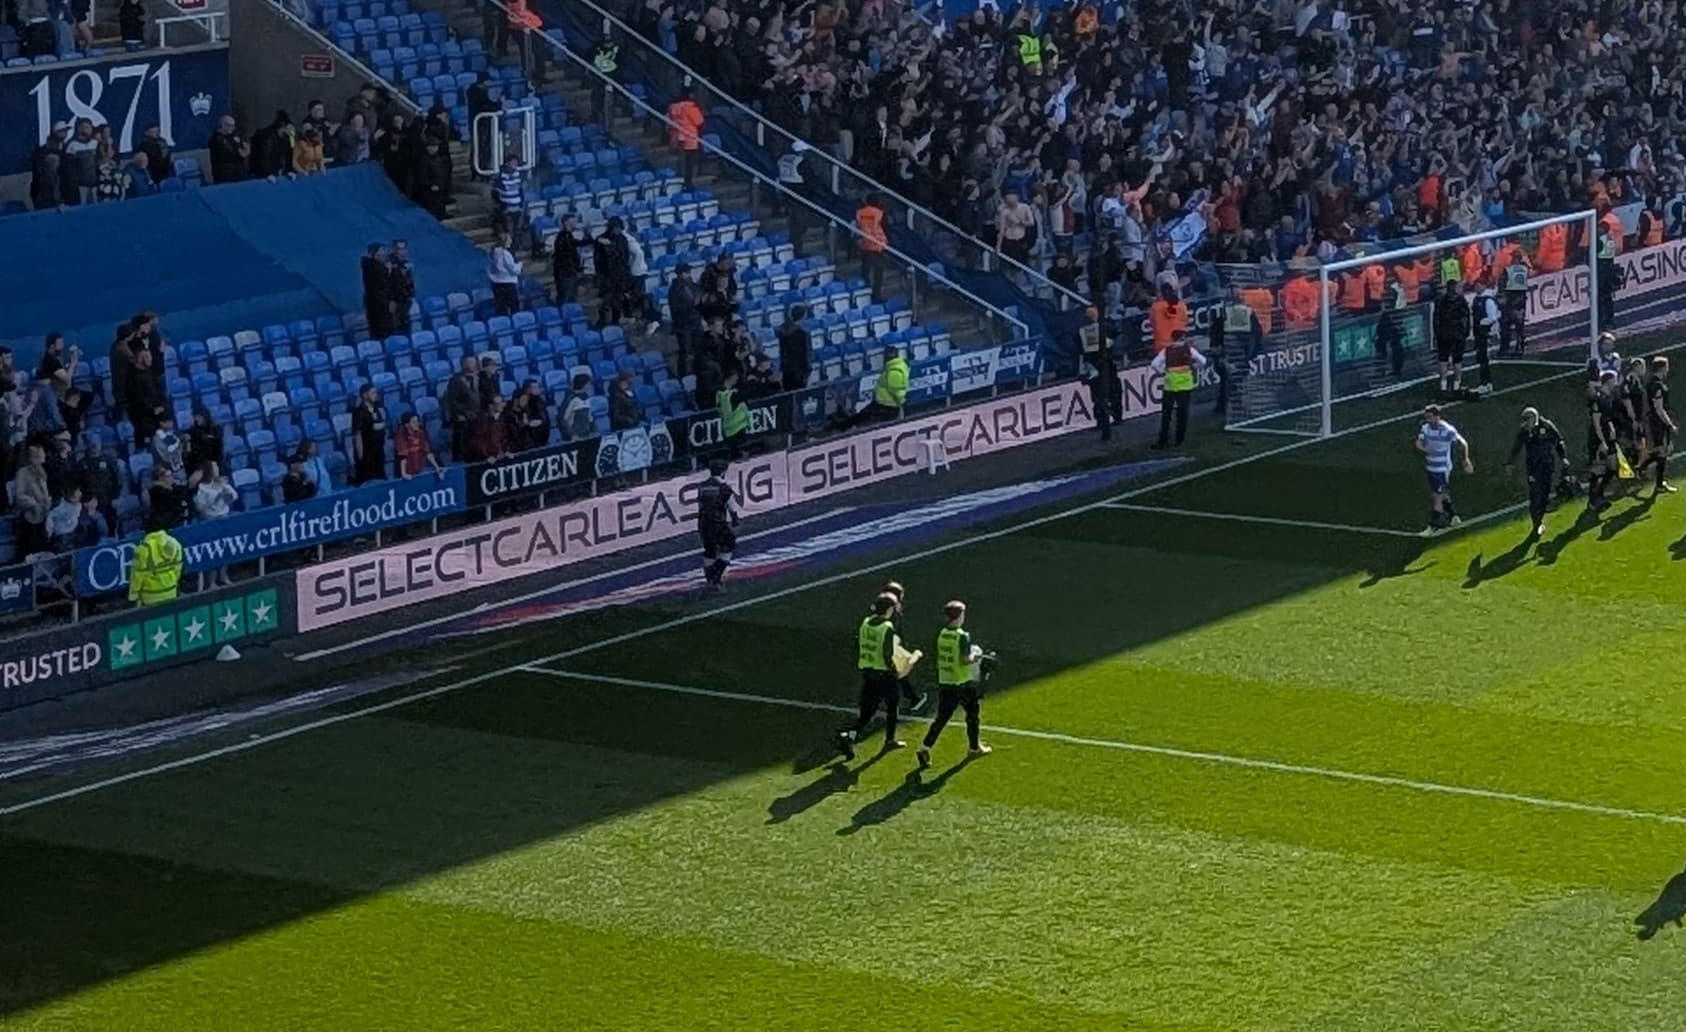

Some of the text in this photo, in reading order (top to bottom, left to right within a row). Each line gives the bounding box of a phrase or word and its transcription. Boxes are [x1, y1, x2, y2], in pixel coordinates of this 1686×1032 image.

[28, 59, 176, 154] 1871
[689, 404, 778, 448] CITEN
[480, 449, 579, 497] CITIZEN
[184, 486, 457, 566] www.crlfireflood.com
[314, 463, 773, 616] SELECTCARLEASNG
[0, 640, 102, 687] RUSTED
